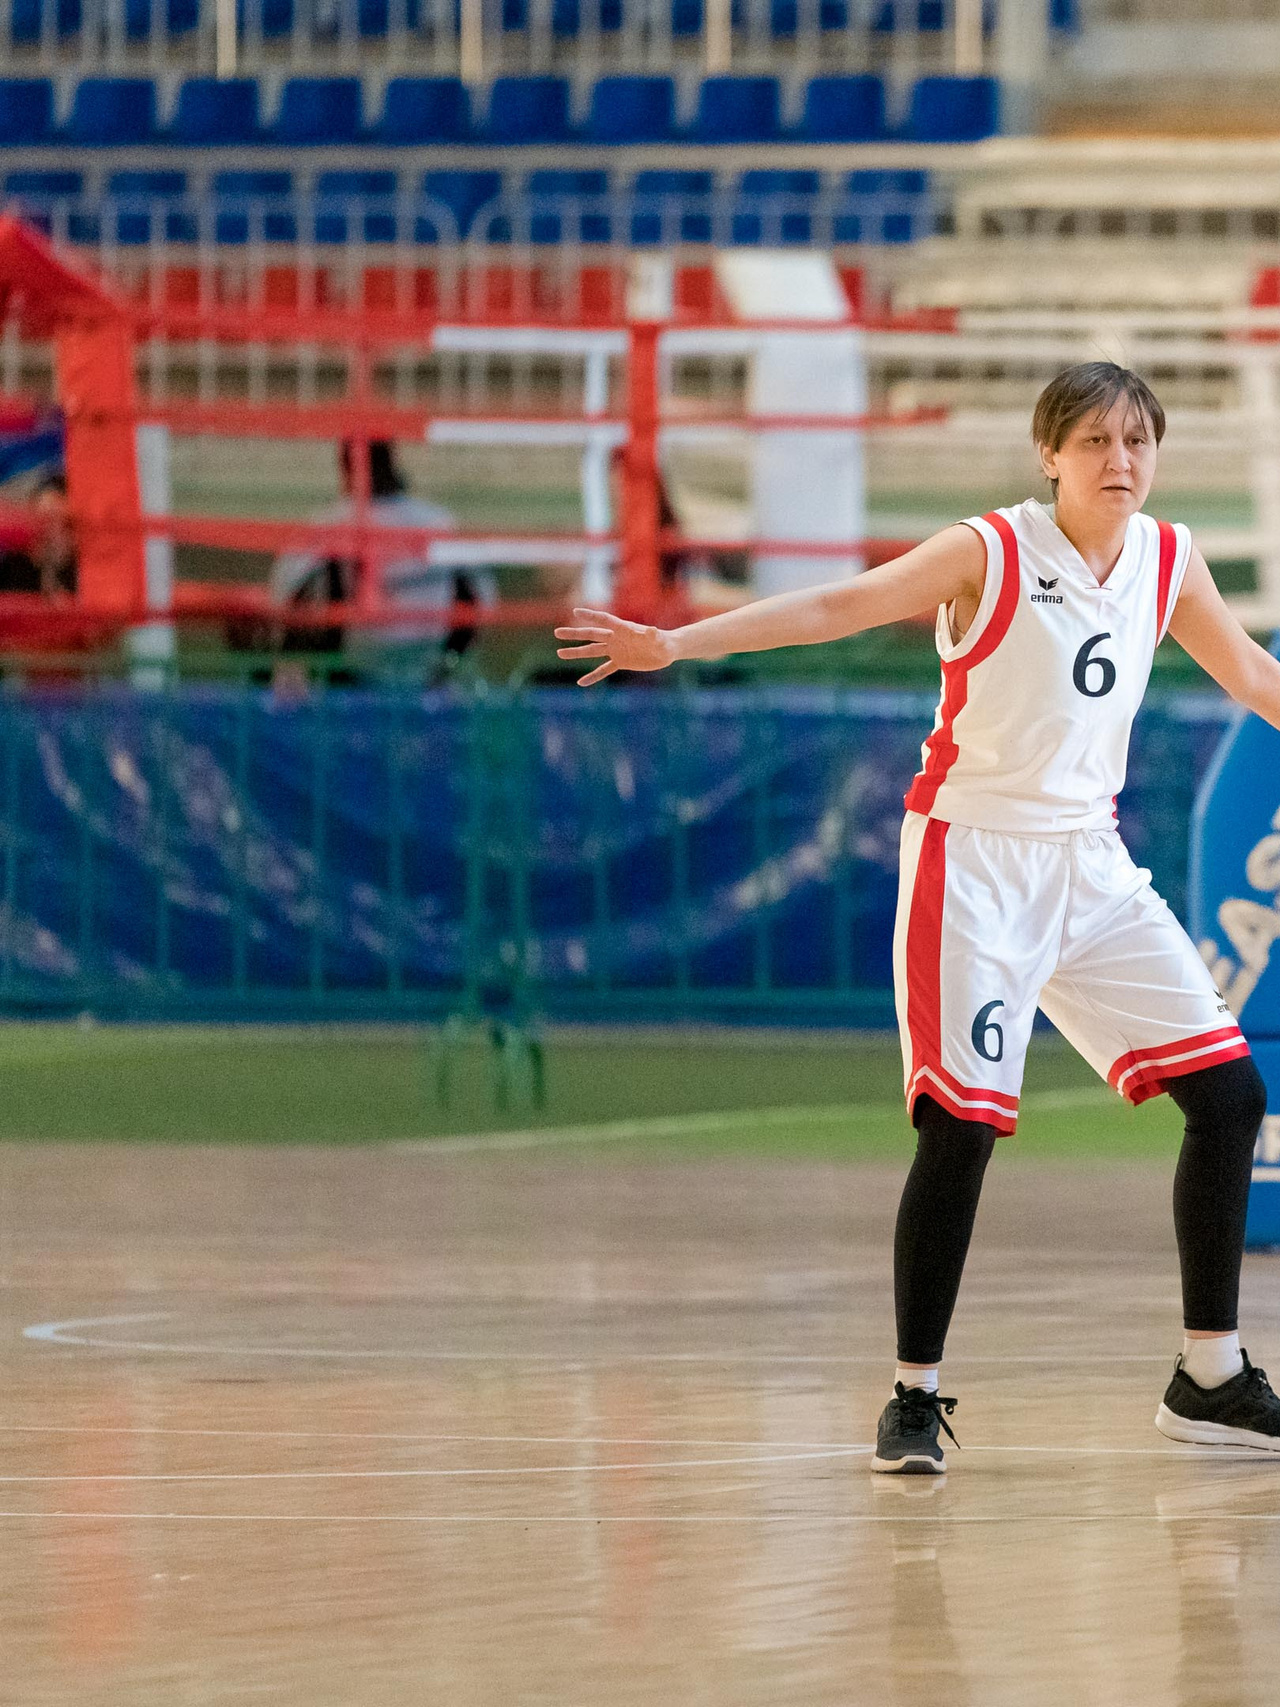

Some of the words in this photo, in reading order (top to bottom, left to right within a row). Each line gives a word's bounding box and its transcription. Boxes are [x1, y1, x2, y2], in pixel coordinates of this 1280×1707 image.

[1030, 593, 1064, 604] erima
[1072, 632, 1116, 698] 6
[971, 999, 1005, 1063] 6
